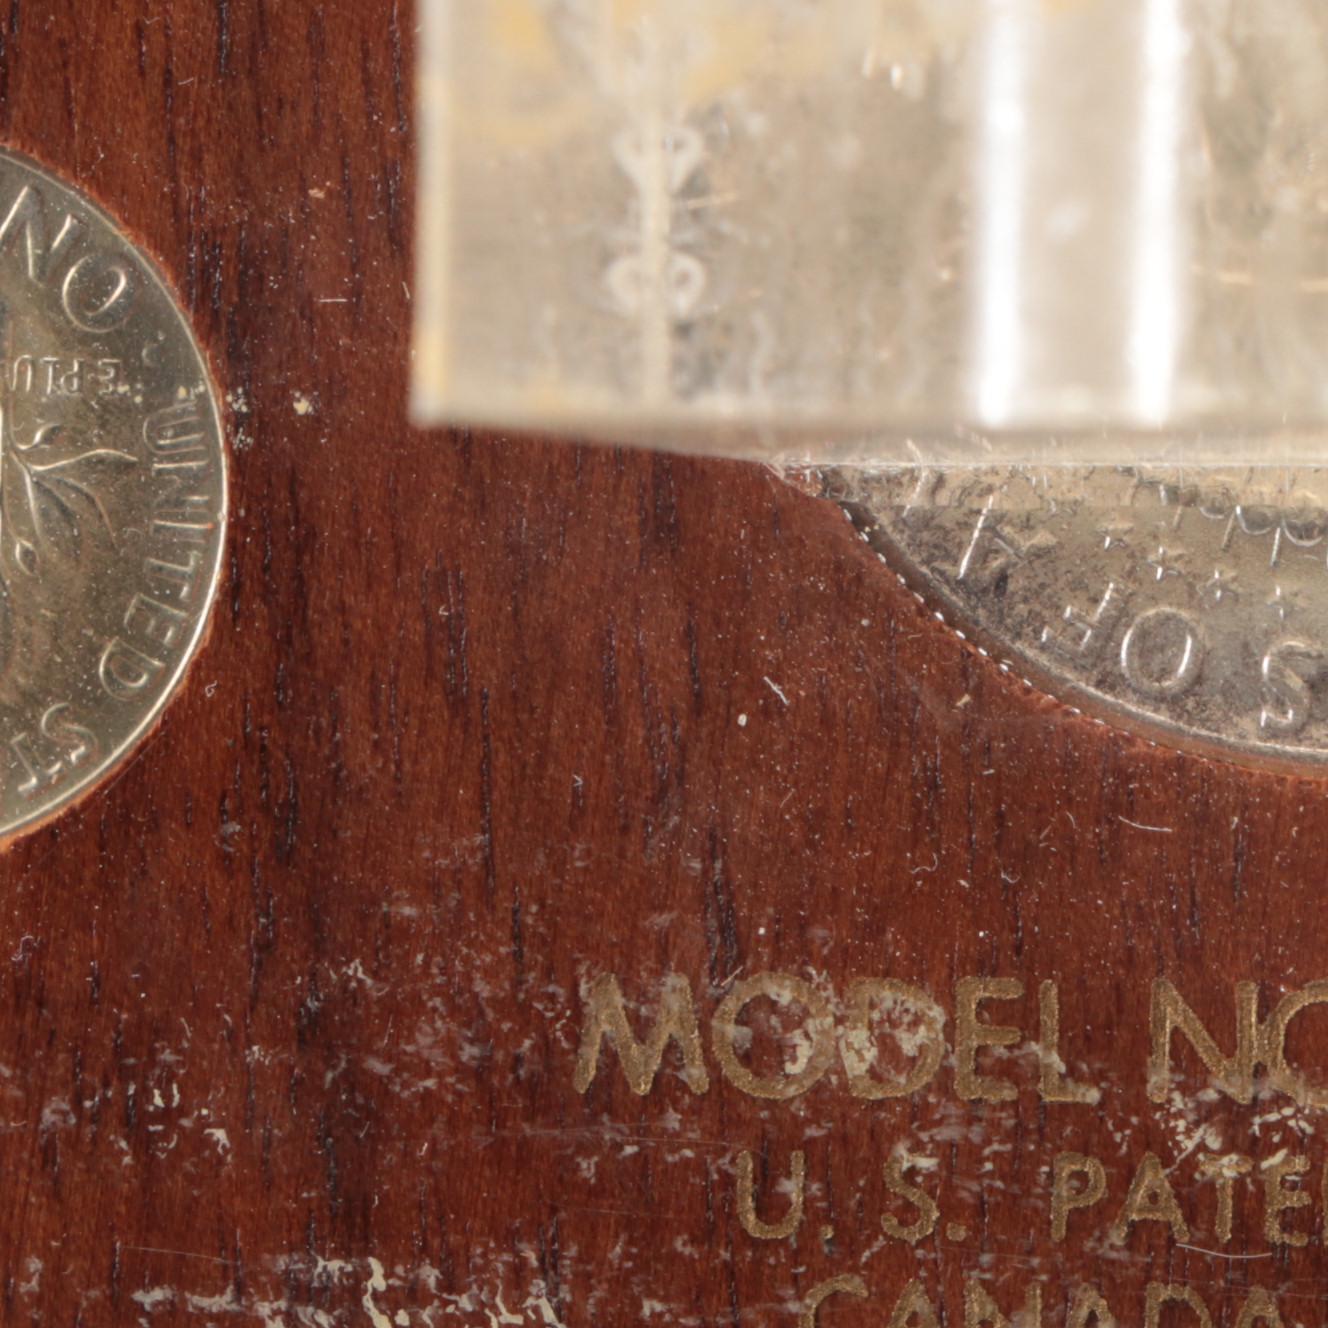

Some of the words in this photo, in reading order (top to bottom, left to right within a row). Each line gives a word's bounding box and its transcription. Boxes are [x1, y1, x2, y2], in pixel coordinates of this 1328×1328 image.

[0, 186, 127, 332] ON
[99, 404, 209, 700] UNITED
[1038, 580, 1206, 697] OF
[574, 972, 1101, 1103] MODEL
